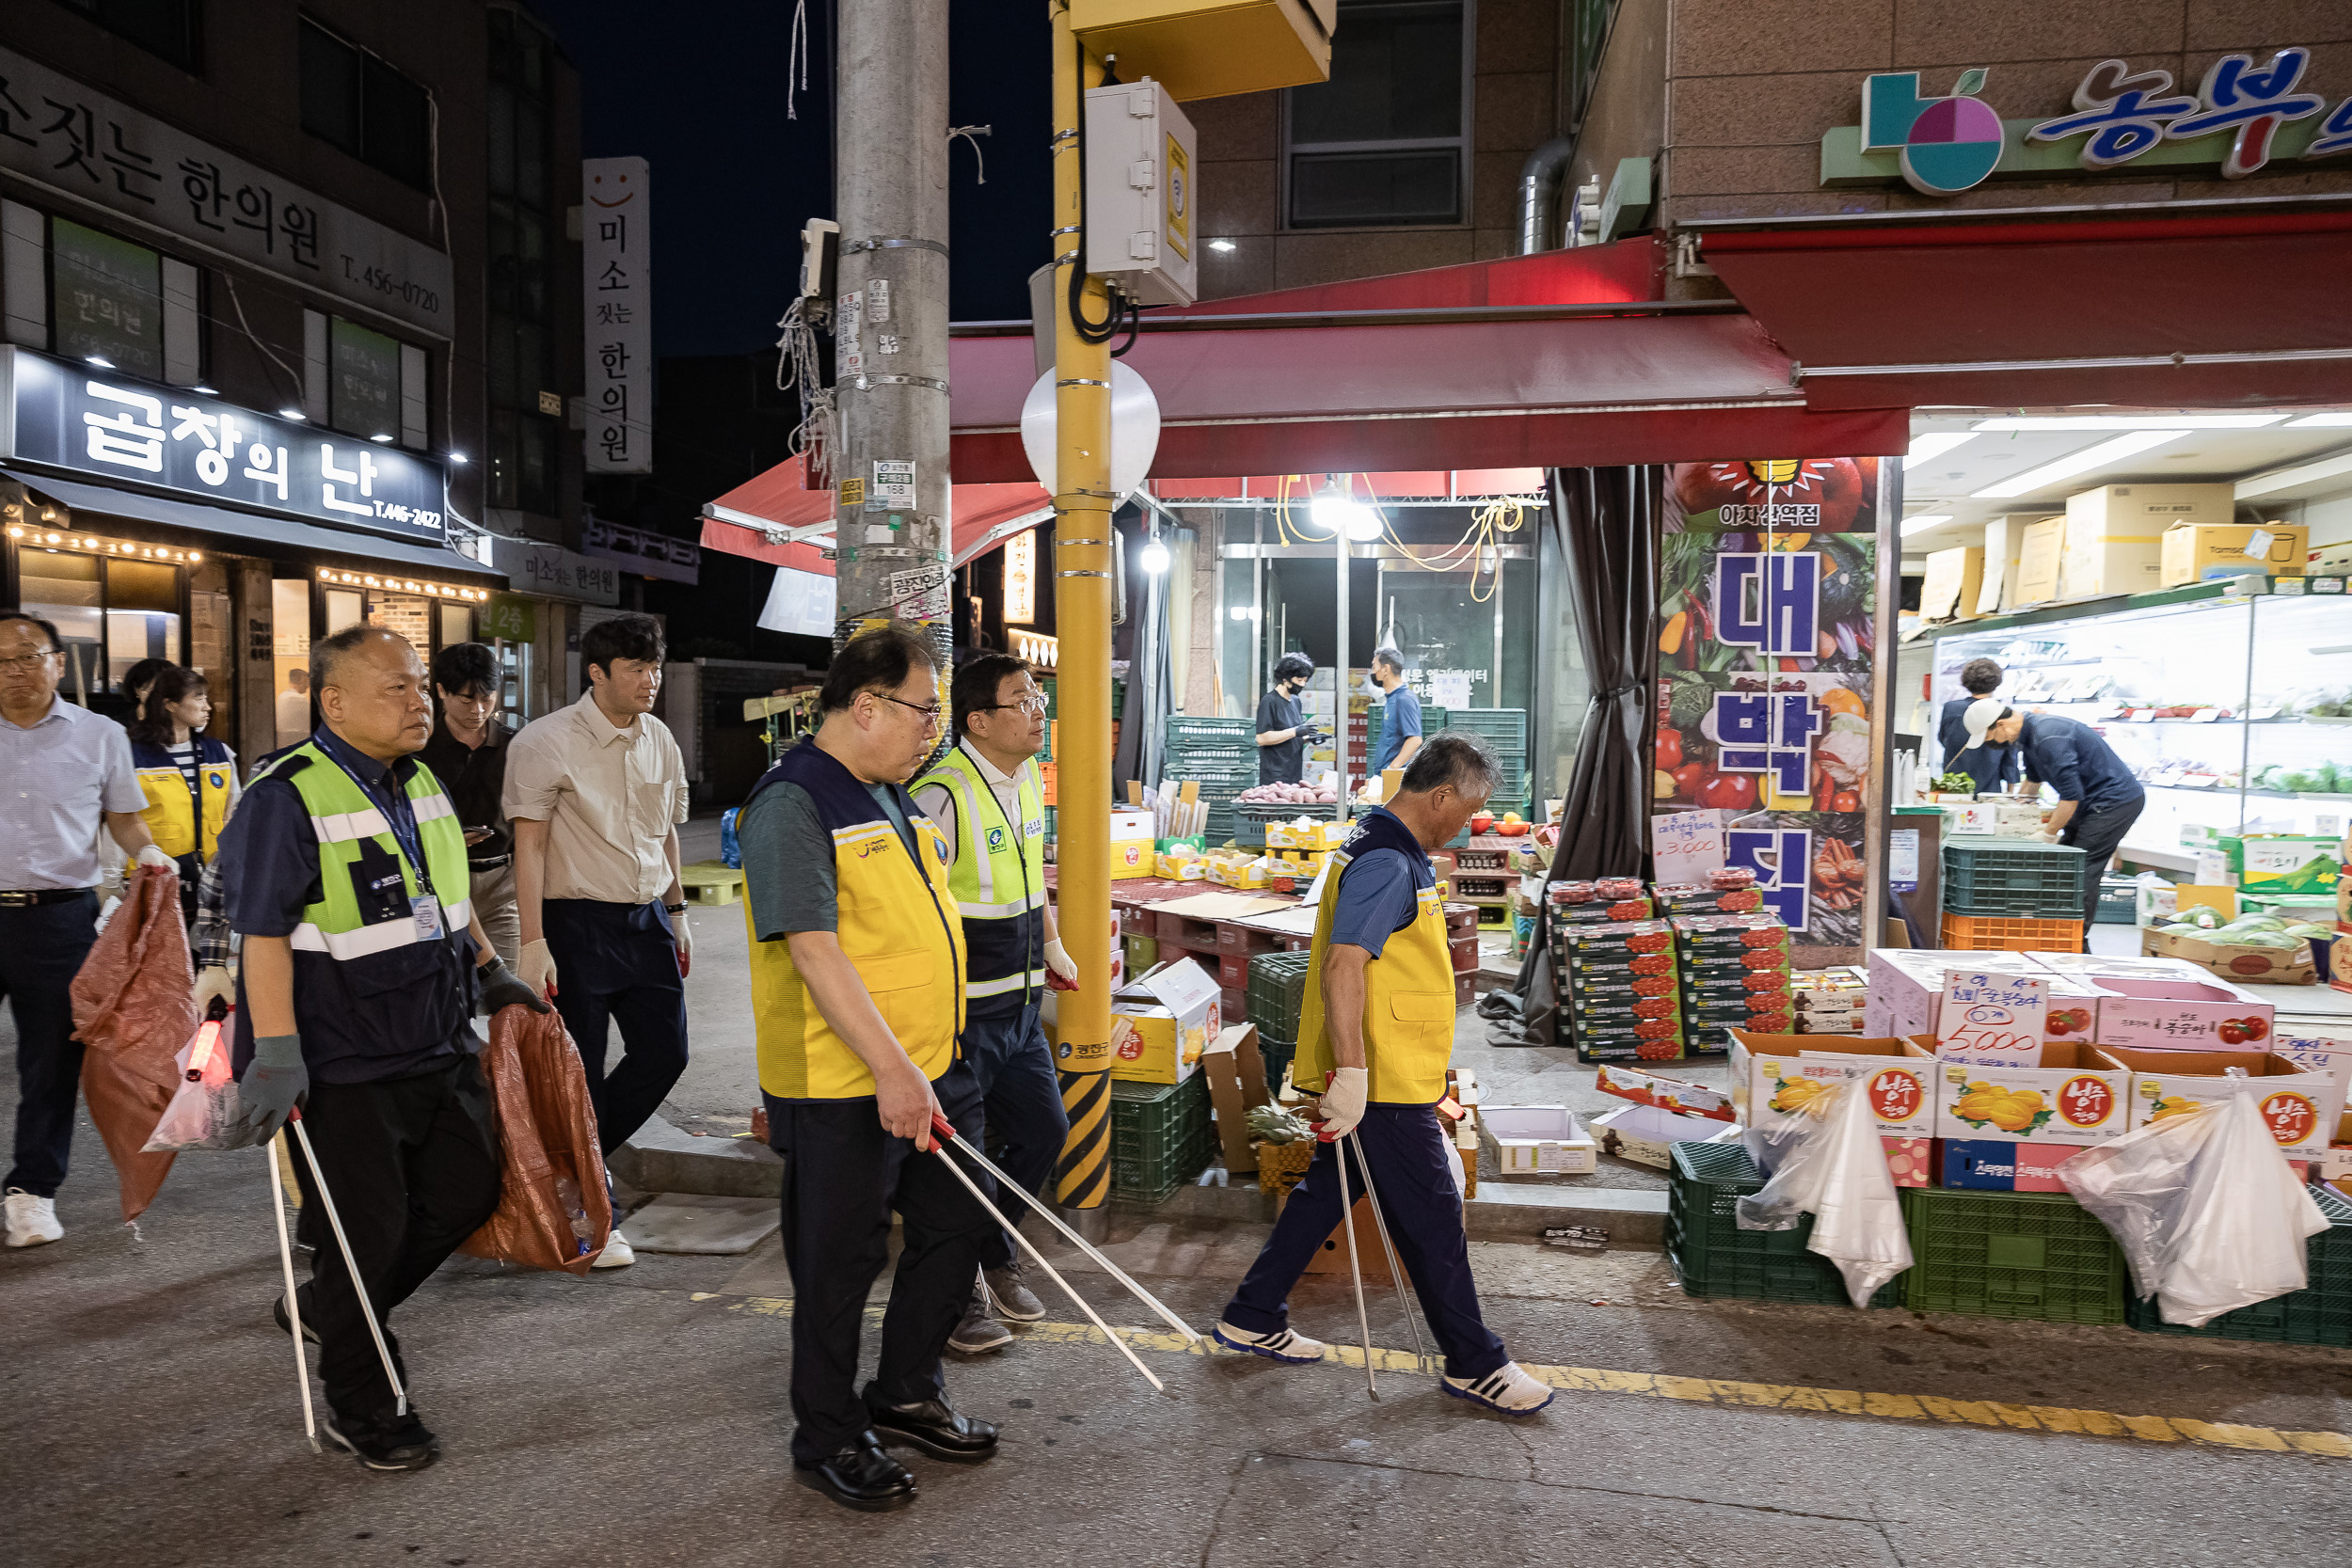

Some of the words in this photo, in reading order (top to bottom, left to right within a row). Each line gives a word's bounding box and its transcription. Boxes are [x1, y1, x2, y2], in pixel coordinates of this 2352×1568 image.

[177, 157, 320, 271] 한의원
[340, 253, 440, 314] T.456-0720
[598, 341, 630, 462] 한의원
[83, 380, 289, 500] 곱창의
[320, 443, 378, 517] 난
[373, 499, 442, 530] T.446-2422
[886, 484, 904, 494] 168
[1720, 504, 1820, 527] 아차산역점
[576, 565, 613, 594] 한의원
[2163, 1019, 2208, 1036] 복숭아
[1875, 1074, 1917, 1105] 성주
[2066, 1082, 2107, 1111] 성주
[2265, 1099, 2309, 1129] 성주
